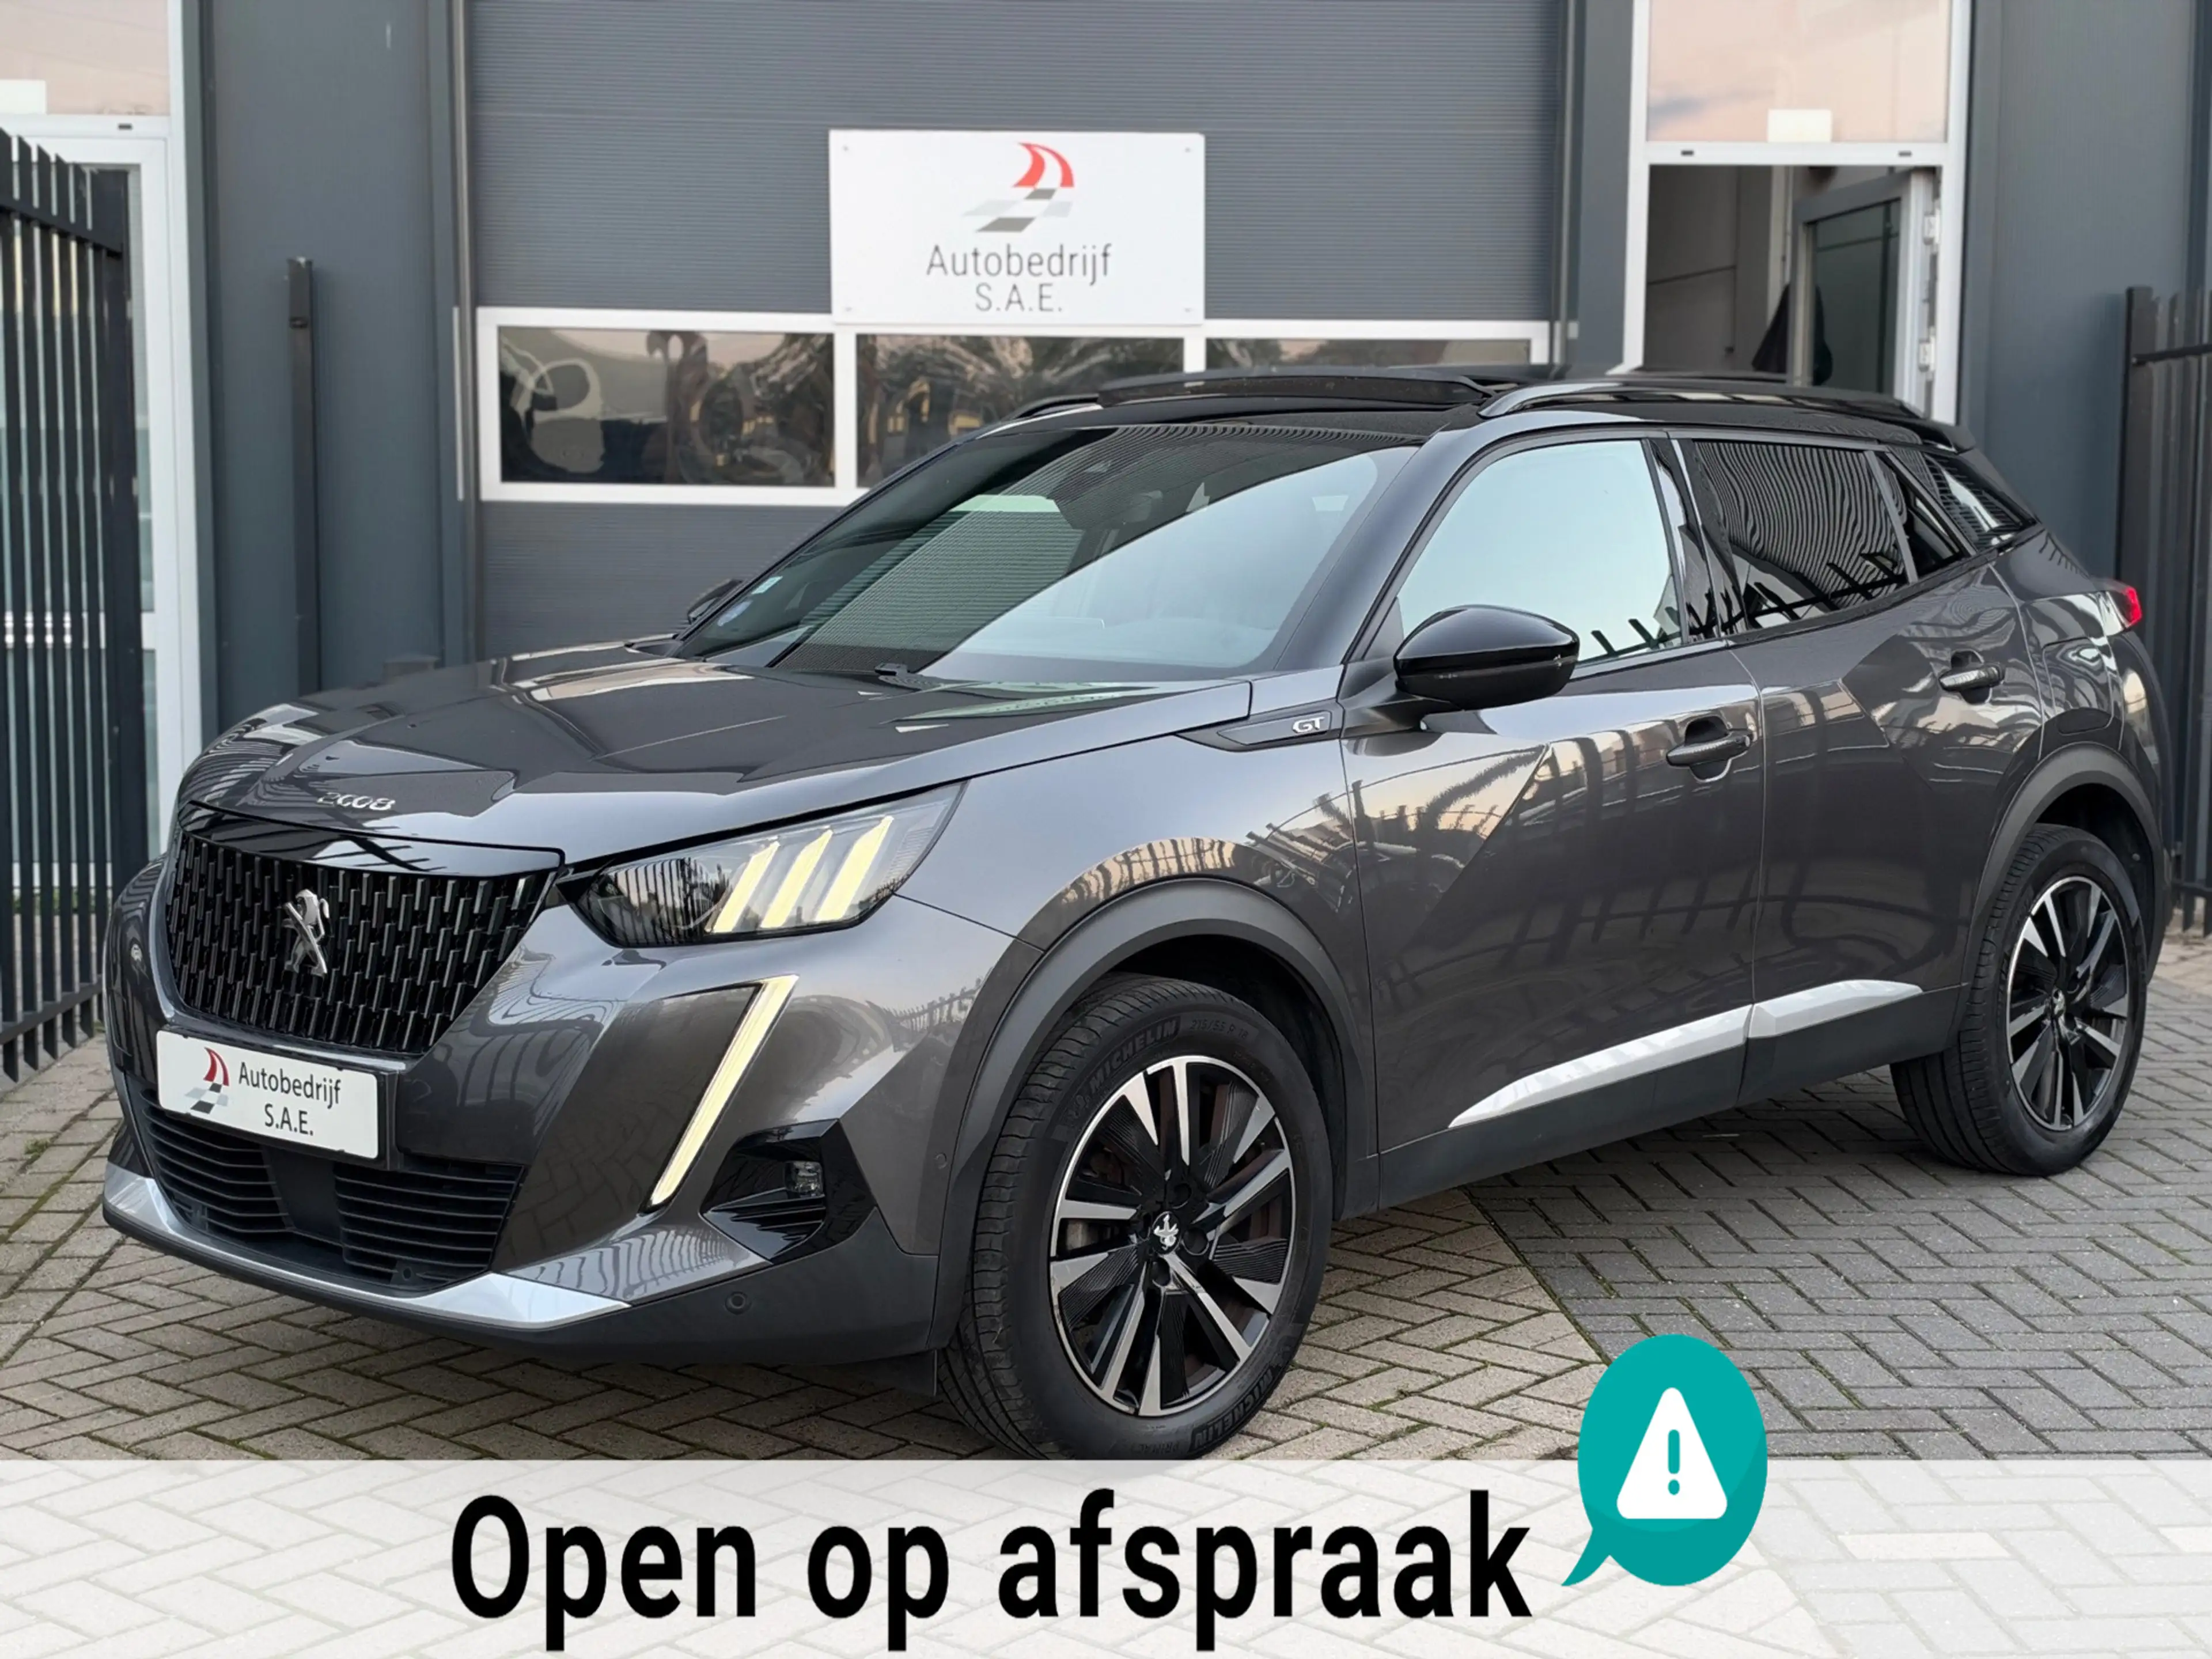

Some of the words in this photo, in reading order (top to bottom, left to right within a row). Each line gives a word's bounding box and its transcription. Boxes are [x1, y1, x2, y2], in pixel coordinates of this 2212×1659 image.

[927, 243, 1111, 286] Autobedrijf
[976, 283, 1063, 312] S.A.E.
[1292, 716, 1325, 733] GT
[316, 791, 396, 811] 2008
[1088, 1020, 1178, 1094] MICHELIN
[238, 1062, 341, 1109] Autobedrijf
[264, 1103, 313, 1137] S.A.E.
[1194, 1369, 1272, 1449] MICHELIN
